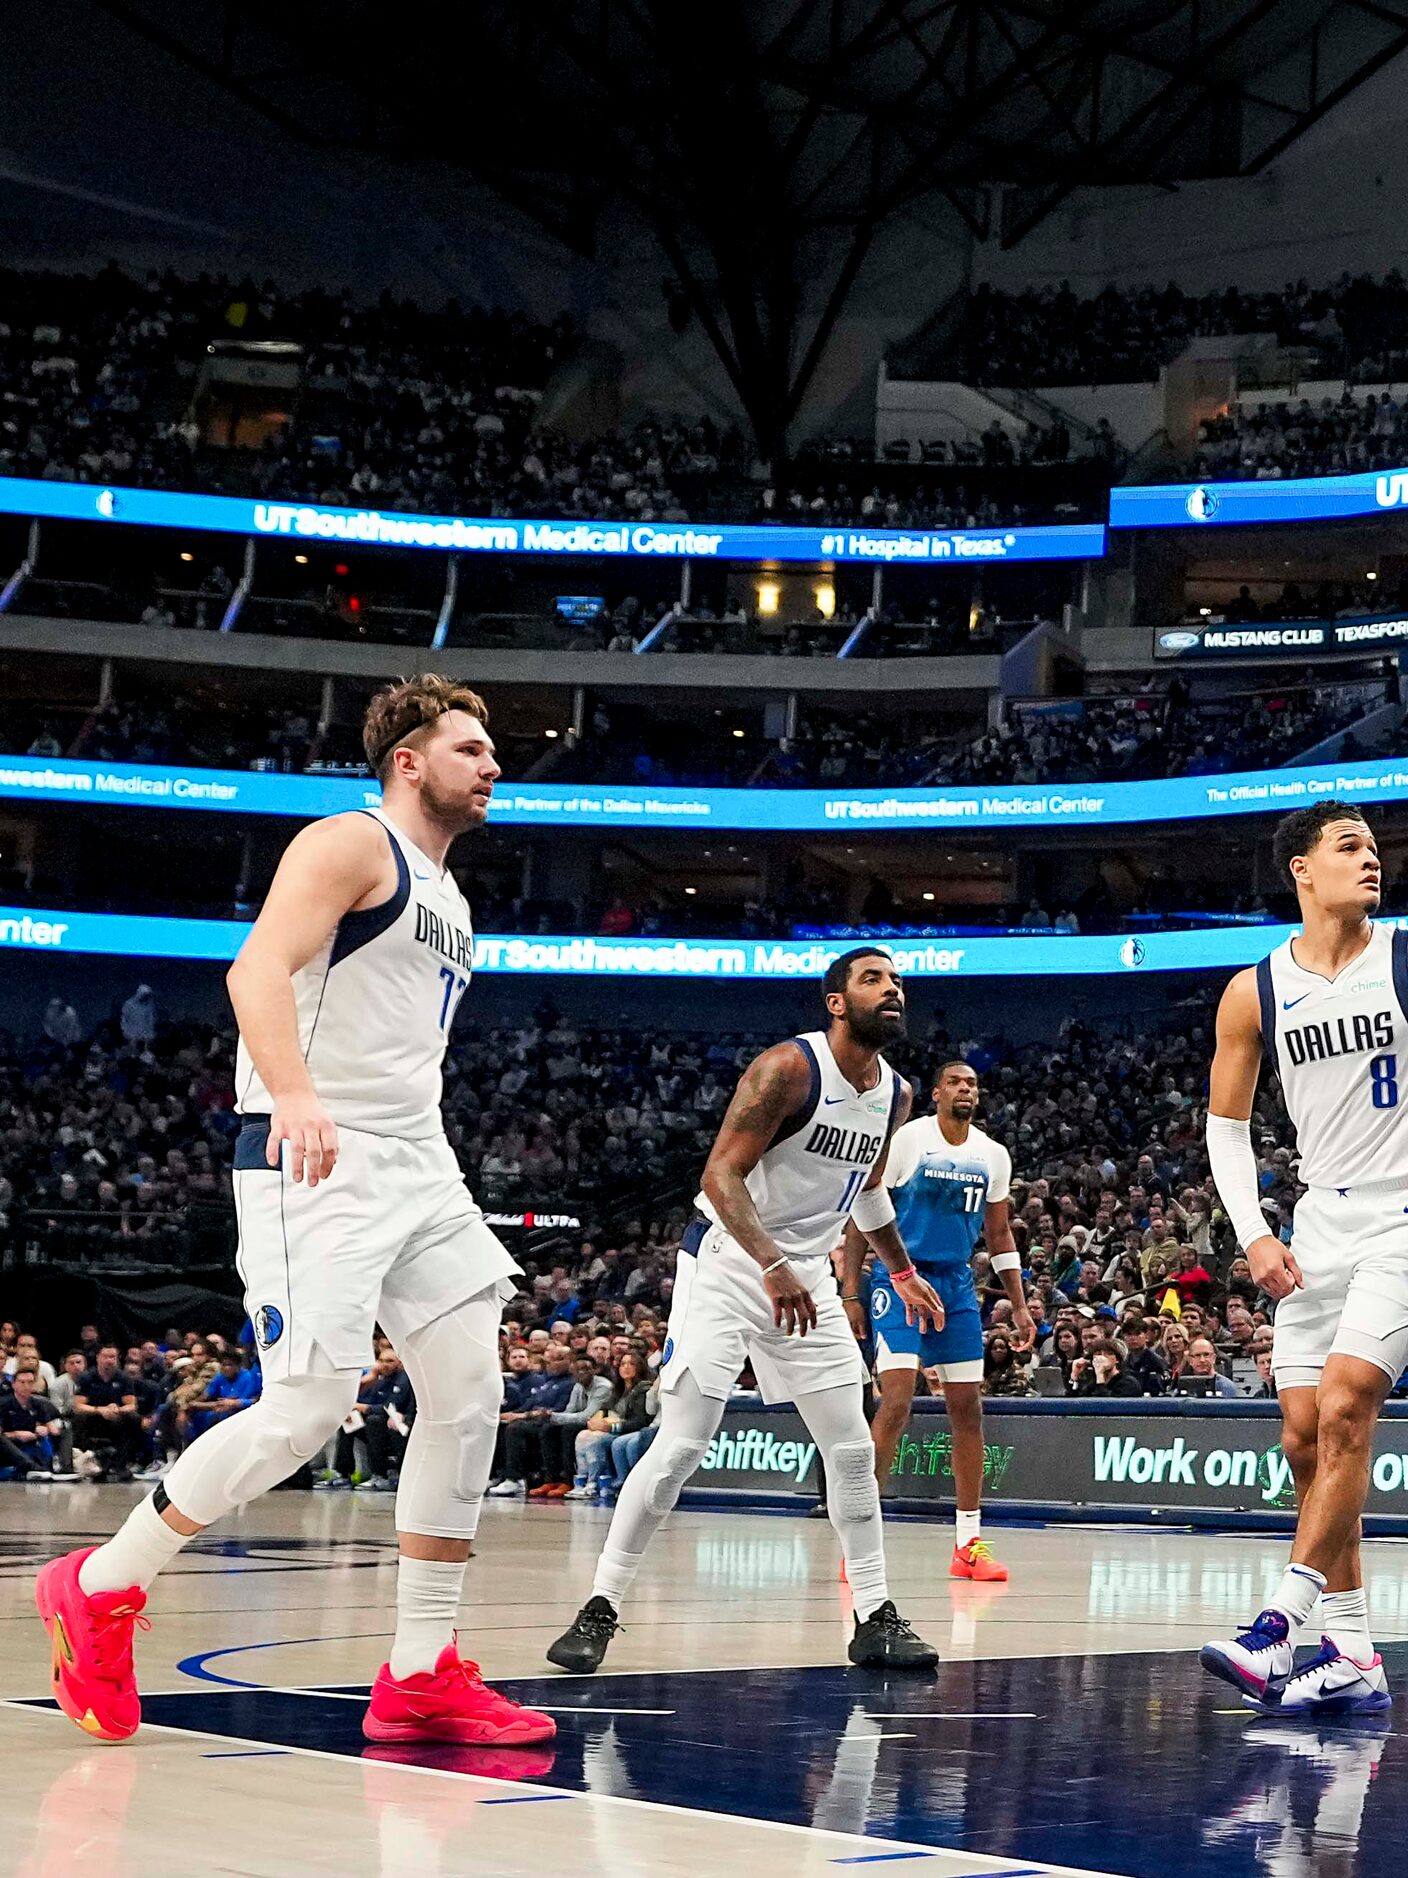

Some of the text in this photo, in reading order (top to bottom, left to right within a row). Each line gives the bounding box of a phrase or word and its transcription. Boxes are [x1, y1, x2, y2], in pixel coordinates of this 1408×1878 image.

[523, 523, 629, 553] Medical
[631, 527, 724, 555] Center
[820, 534, 845, 556] #1
[848, 534, 929, 561] Hospital
[931, 536, 951, 557] in
[1204, 630, 1280, 647] MUSTANG
[1281, 628, 1324, 645] CLUB
[95, 773, 171, 796] Medical
[172, 778, 239, 800] Center
[1206, 788, 1228, 803] The
[1229, 786, 1268, 801] Official
[1269, 782, 1306, 798] Health
[1306, 779, 1335, 793] Care
[1335, 776, 1379, 791] Partner
[1379, 773, 1393, 786] of
[514, 797, 563, 811] Partner
[563, 798, 580, 812] of
[579, 798, 602, 812] the
[981, 797, 1048, 815] Medical
[1049, 796, 1105, 814] Center
[414, 902, 472, 972] DALLAS
[1350, 978, 1387, 994] chime
[1284, 1010, 1394, 1067] DALLAS
[1369, 1053, 1399, 1109] 8
[803, 1123, 882, 1165] DALLAS
[924, 1168, 985, 1184] MINNESOTA
[836, 1170, 866, 1213] 11
[963, 1186, 984, 1213] 11
[701, 1428, 817, 1483] shiftkey
[1093, 1435, 1198, 1486] Work
[1203, 1448, 1256, 1487] on
